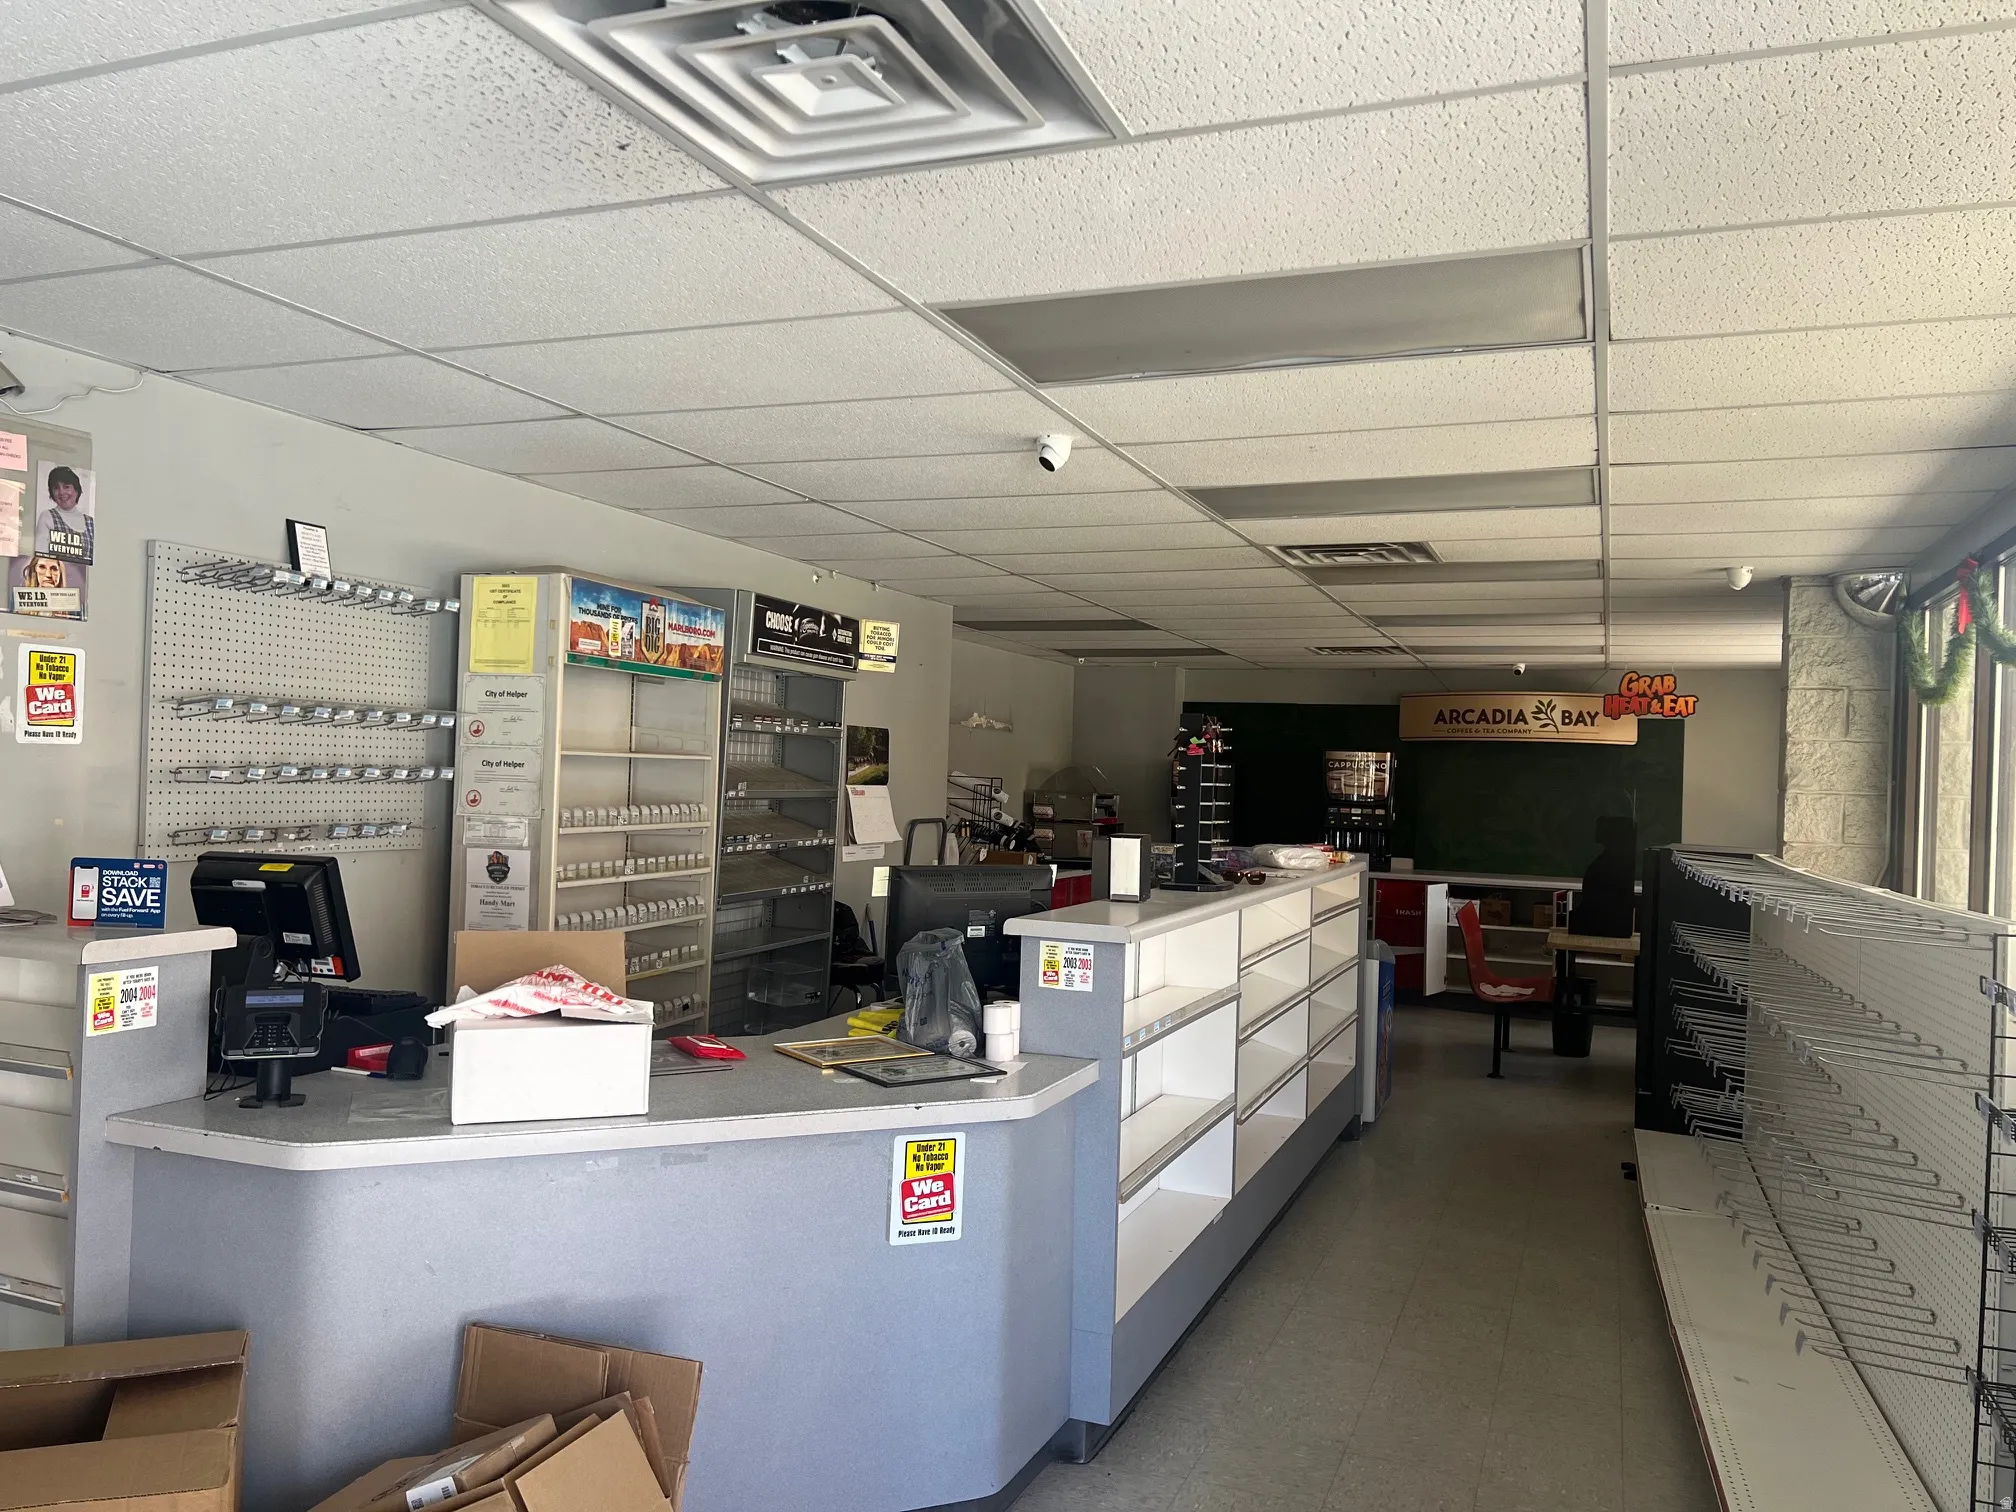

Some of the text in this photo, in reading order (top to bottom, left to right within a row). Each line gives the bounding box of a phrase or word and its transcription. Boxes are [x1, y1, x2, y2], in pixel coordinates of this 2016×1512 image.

[50, 530, 82, 546] WE I.D.
[49, 544, 82, 556] EVERYONE
[18, 592, 47, 600] WE I.D.
[578, 606, 611, 619] THOUSANDS
[597, 603, 622, 614] MINE FOR
[646, 616, 660, 635] BIG
[765, 610, 793, 633] CHOOSE
[668, 622, 715, 638] MARLBORO.COM
[646, 635, 660, 653] DIG
[40, 655, 57, 663] Under
[46, 664, 69, 673] Tobacco
[49, 672, 66, 681] Vapor
[1620, 672, 1676, 698] GRAB
[35, 687, 65, 701] We
[506, 691, 528, 699] Helper
[28, 699, 72, 715] Card
[1604, 694, 1698, 719] HEAT & EAT
[1434, 708, 1599, 726] ARCADIA BAY
[503, 761, 525, 769] Helper
[1328, 762, 1387, 770] CAPPUCCNO
[102, 876, 147, 888] STACK
[101, 888, 161, 907] SAVE
[480, 899, 498, 907] Handy
[1063, 957, 1077, 969] 2003
[1078, 957, 1092, 970] 2003
[120, 985, 156, 1004] 2004 2004
[94, 1016, 113, 1026] Card
[917, 1142, 945, 1152] Under 21
[912, 1152, 948, 1162] No Tobacco
[916, 1162, 945, 1172] No Vapor
[911, 1179, 944, 1196] We
[904, 1190, 951, 1212] Card
[898, 1229, 916, 1238] Please
[940, 1226, 955, 1234] Ready
